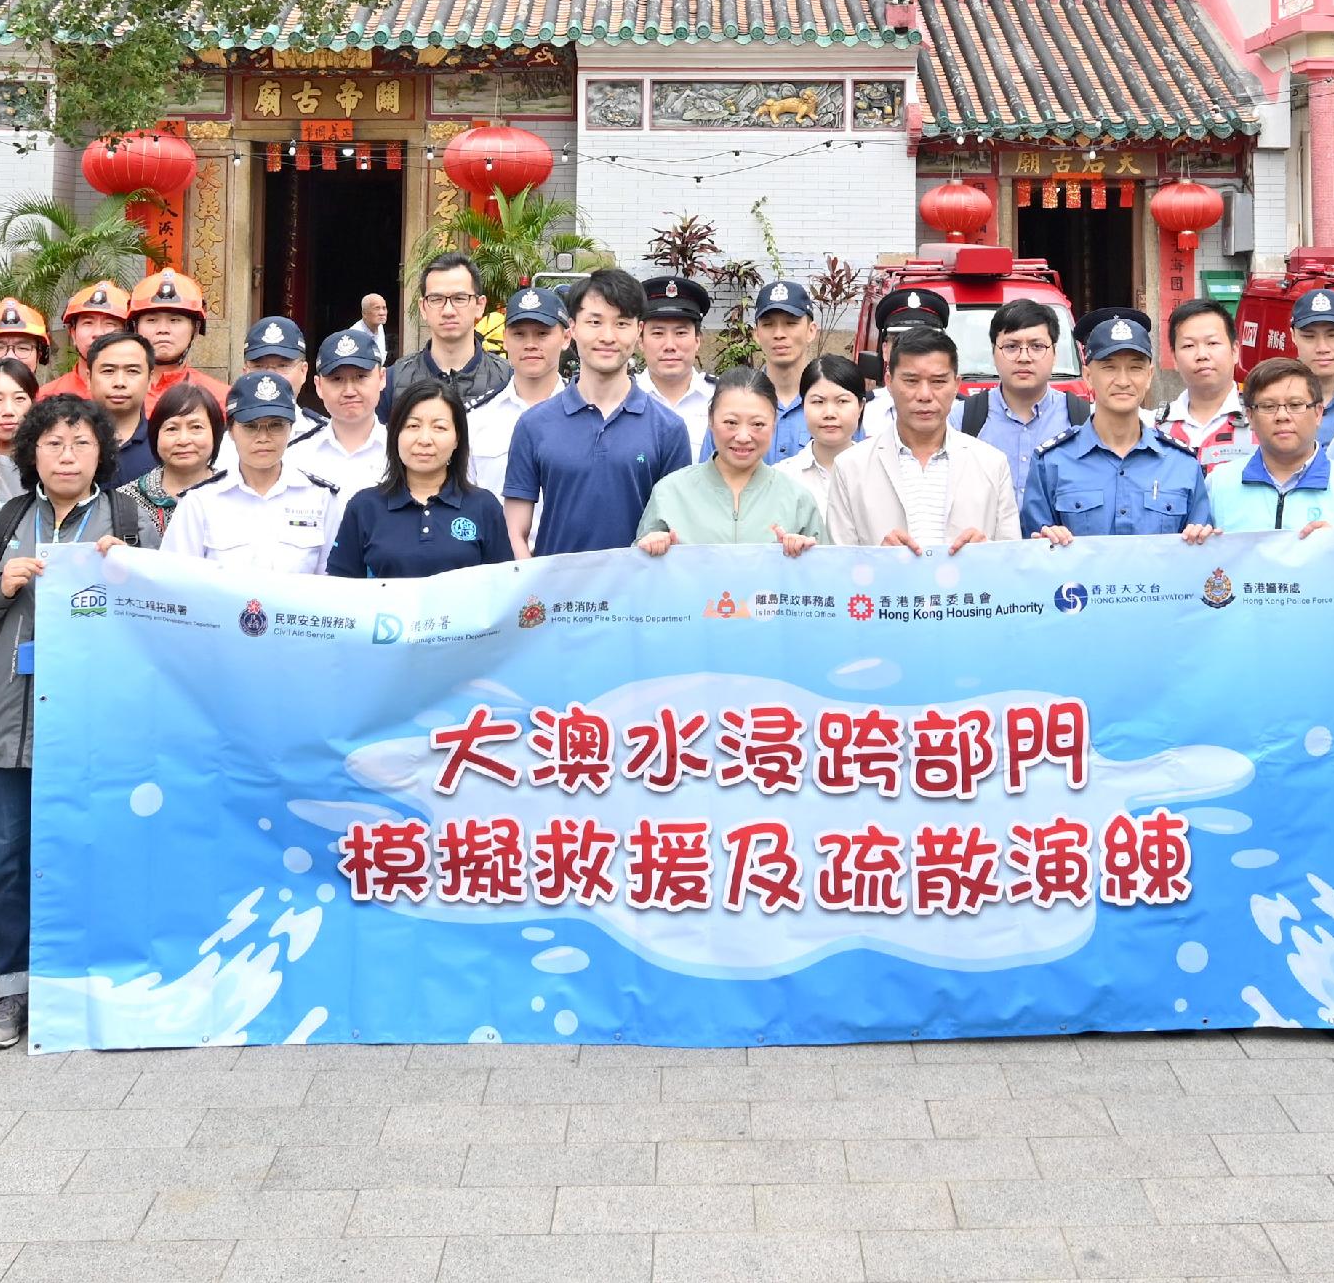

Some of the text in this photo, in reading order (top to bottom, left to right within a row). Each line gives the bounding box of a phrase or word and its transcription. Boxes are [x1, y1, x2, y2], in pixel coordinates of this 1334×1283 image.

[1091, 583, 1161, 595] 香港天文台
[1242, 582, 1301, 594] 香港警務處
[70, 595, 107, 608] CEDD
[755, 593, 836, 608] 離島民政事務處
[879, 591, 992, 608] 香港房屋委員會
[1091, 593, 1194, 605] HONG KONG OBSERVATORY
[1242, 598, 1263, 606] Hong
[114, 596, 188, 616] 土木工程拓展署
[551, 600, 609, 613] 香港消防處
[879, 601, 1045, 622] Hong Kong Housing Authority
[275, 612, 357, 630] 民眾安全服務隊
[573, 616, 593, 624] Kong
[611, 615, 644, 623] Services
[645, 615, 691, 623] Department
[305, 630, 335, 640] Service
[432, 701, 1088, 795] 大澳水浸跨部門
[341, 810, 1192, 914] 模擬救援及疏散演練
